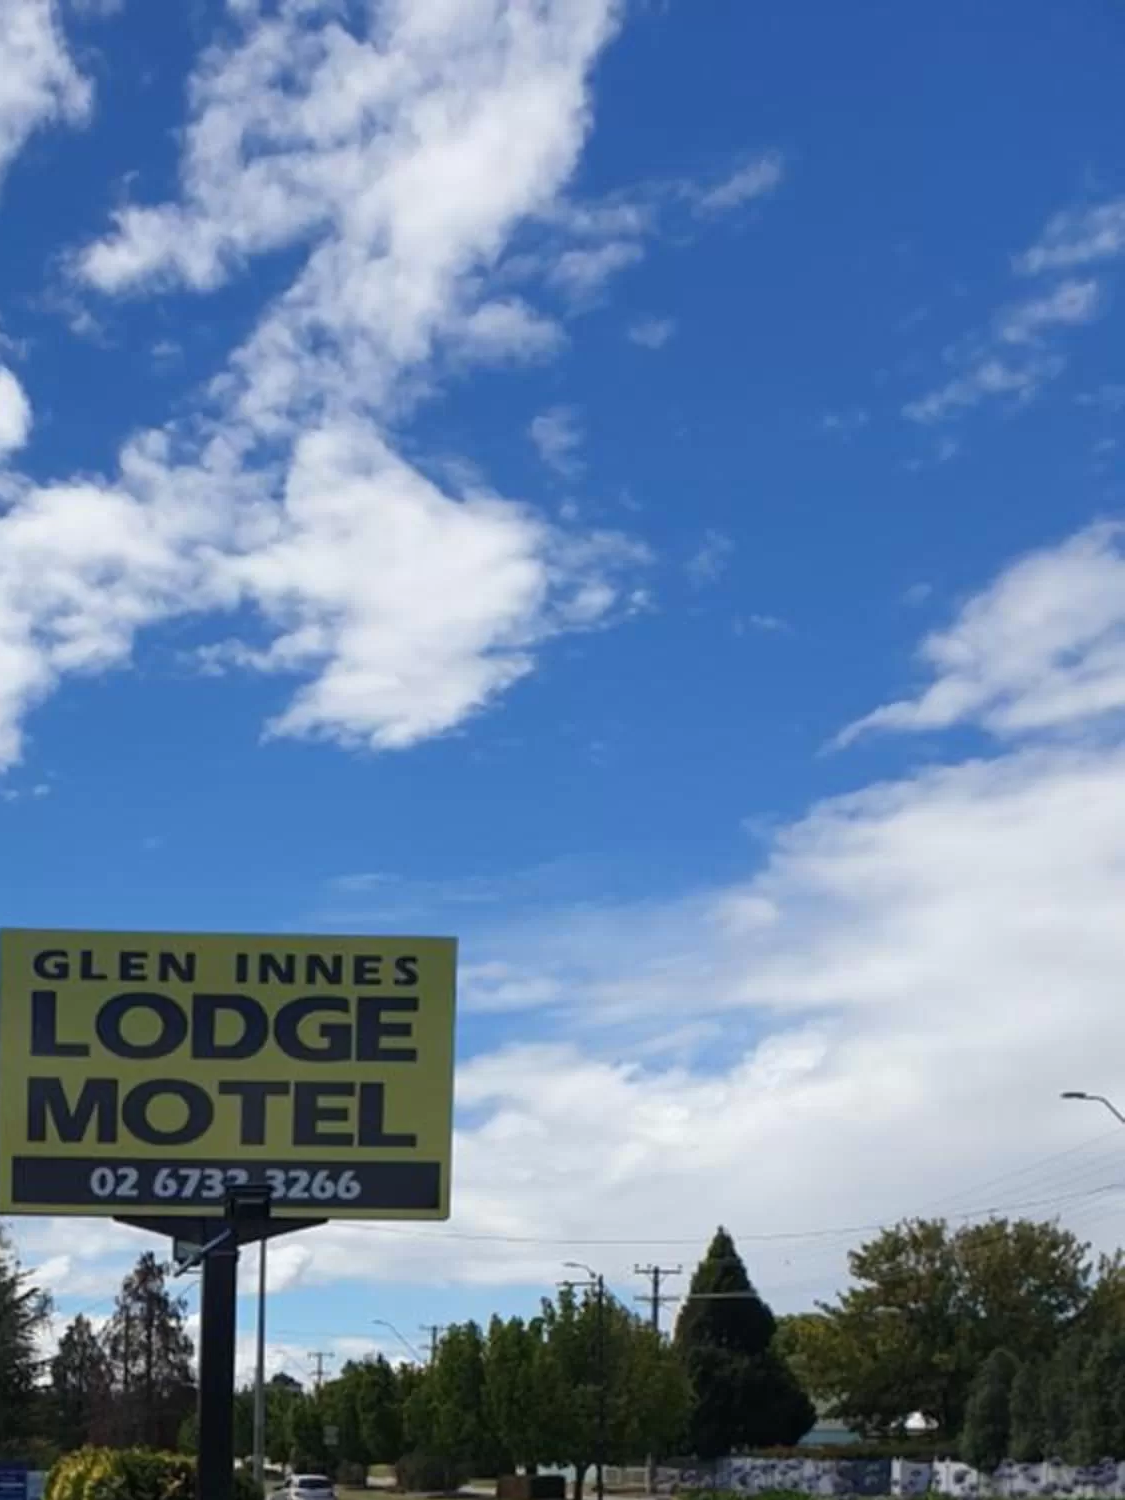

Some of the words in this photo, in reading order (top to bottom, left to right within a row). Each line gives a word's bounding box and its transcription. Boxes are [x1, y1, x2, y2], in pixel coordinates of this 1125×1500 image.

[32, 949, 196, 983] GLEN
[235, 953, 420, 986] INNES
[29, 990, 420, 1062] LODGE
[26, 1076, 418, 1148] MOTEL
[90, 1166, 139, 1197] 02
[265, 1169, 362, 1200] 3266
